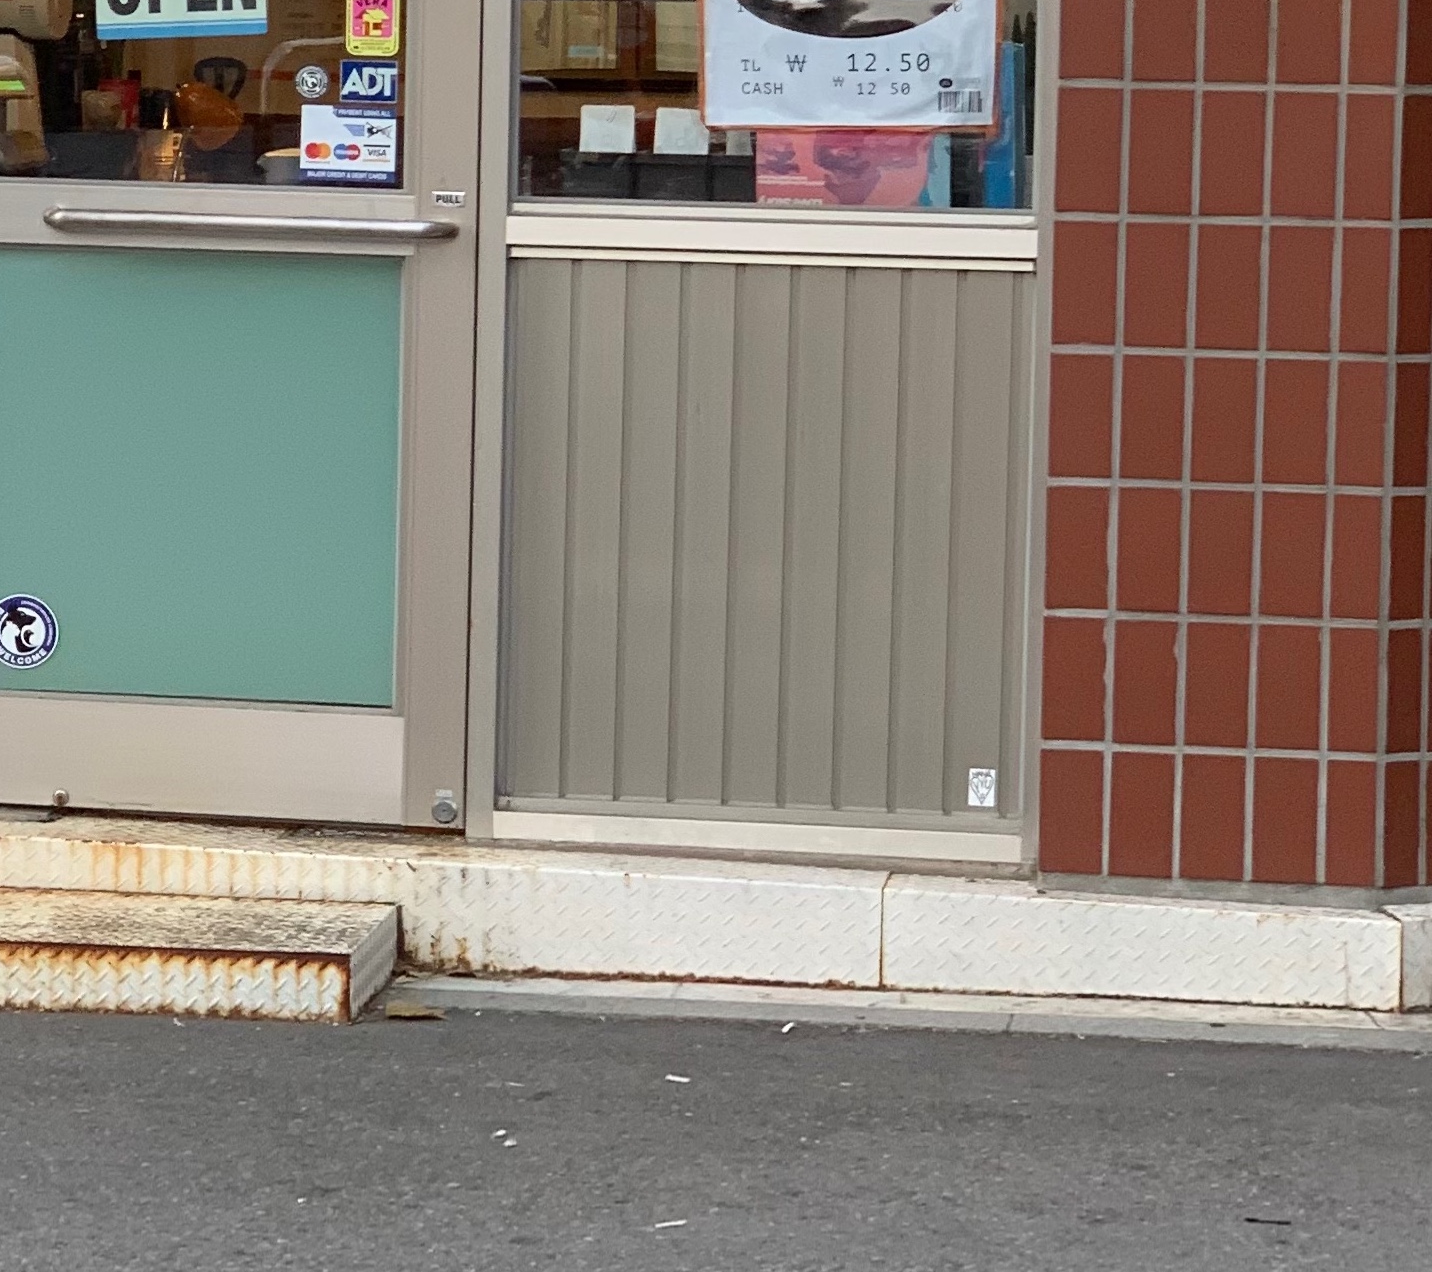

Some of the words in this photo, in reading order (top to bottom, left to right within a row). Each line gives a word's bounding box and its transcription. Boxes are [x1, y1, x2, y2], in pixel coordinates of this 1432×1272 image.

[741, 59, 761, 72] TL
[847, 52, 931, 73] 12.50
[341, 67, 398, 97] ADT
[741, 82, 784, 95] CASH
[367, 149, 387, 157] VISA
[435, 194, 461, 204] PULL
